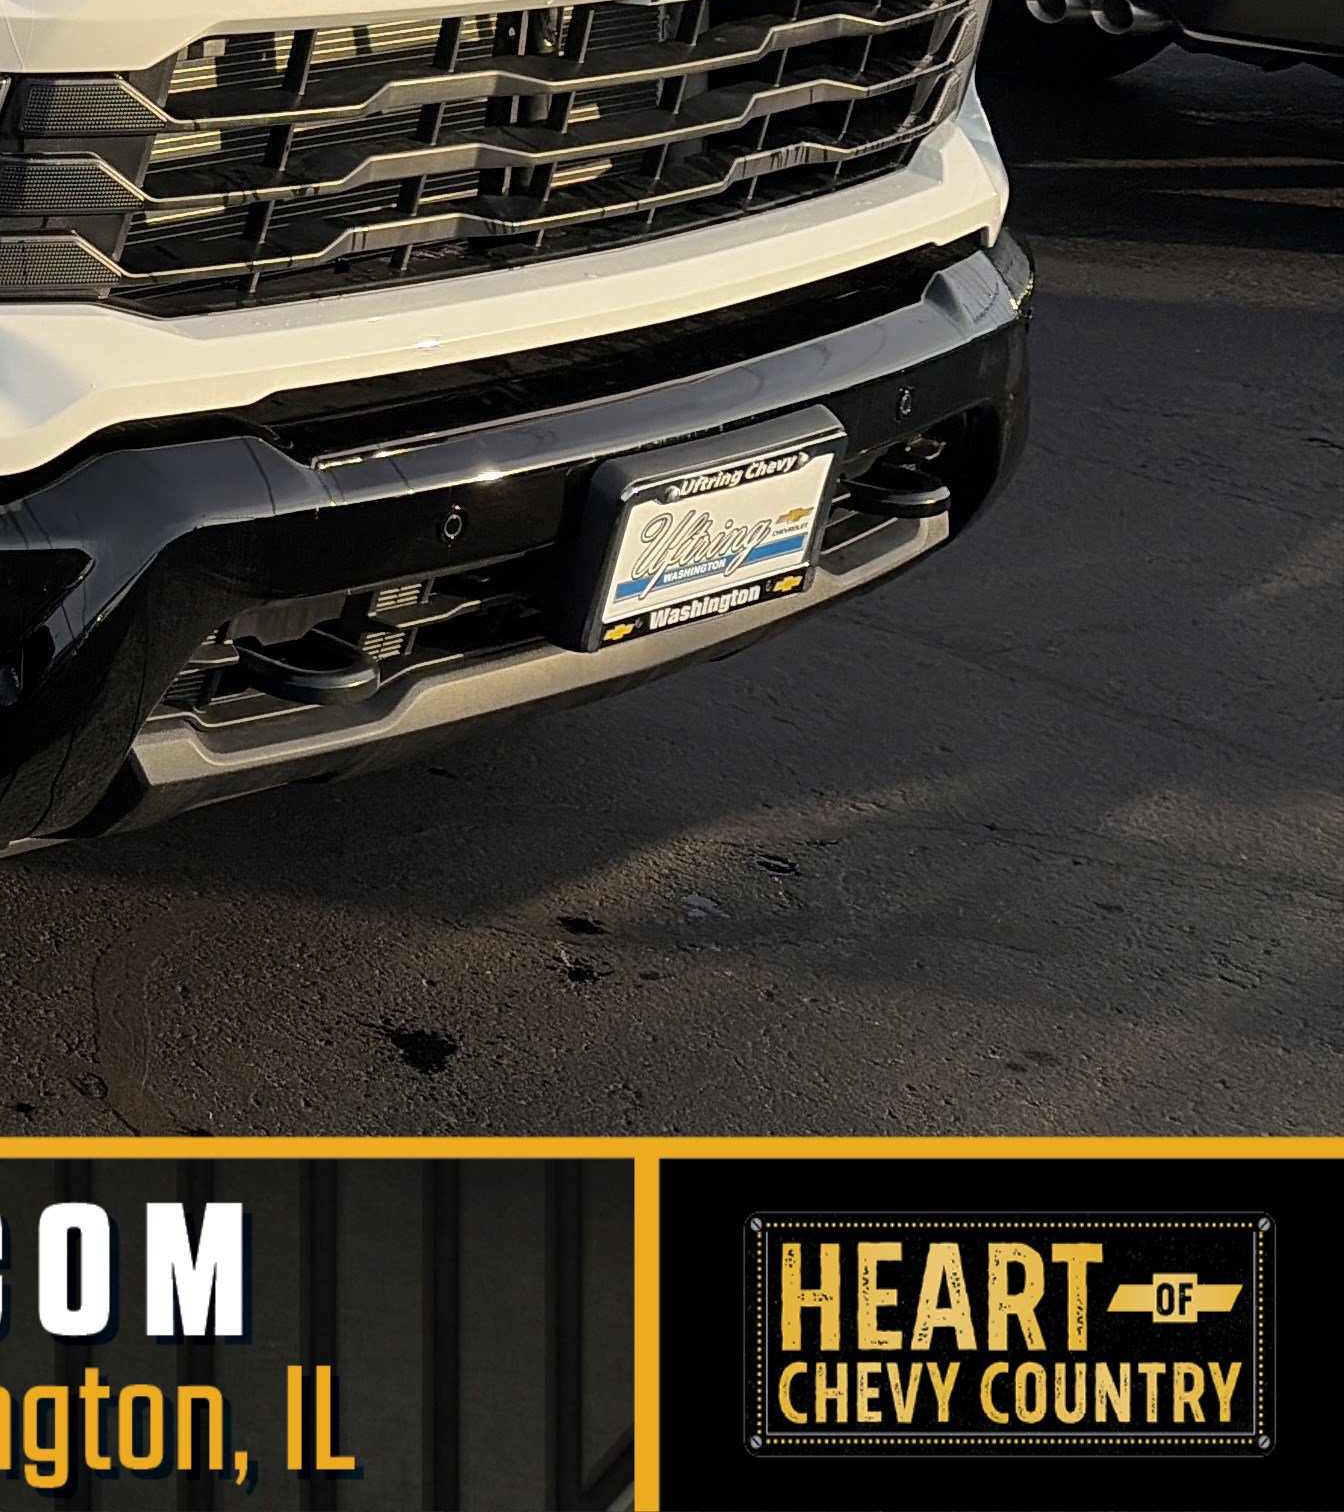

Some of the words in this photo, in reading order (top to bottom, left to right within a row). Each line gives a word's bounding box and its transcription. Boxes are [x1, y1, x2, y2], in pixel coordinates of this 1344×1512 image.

[680, 471, 743, 497] Uftring
[745, 454, 797, 481] Chevy
[631, 509, 773, 601] Uftring
[663, 559, 727, 583] WASHINGTON
[649, 584, 762, 630] Washington
